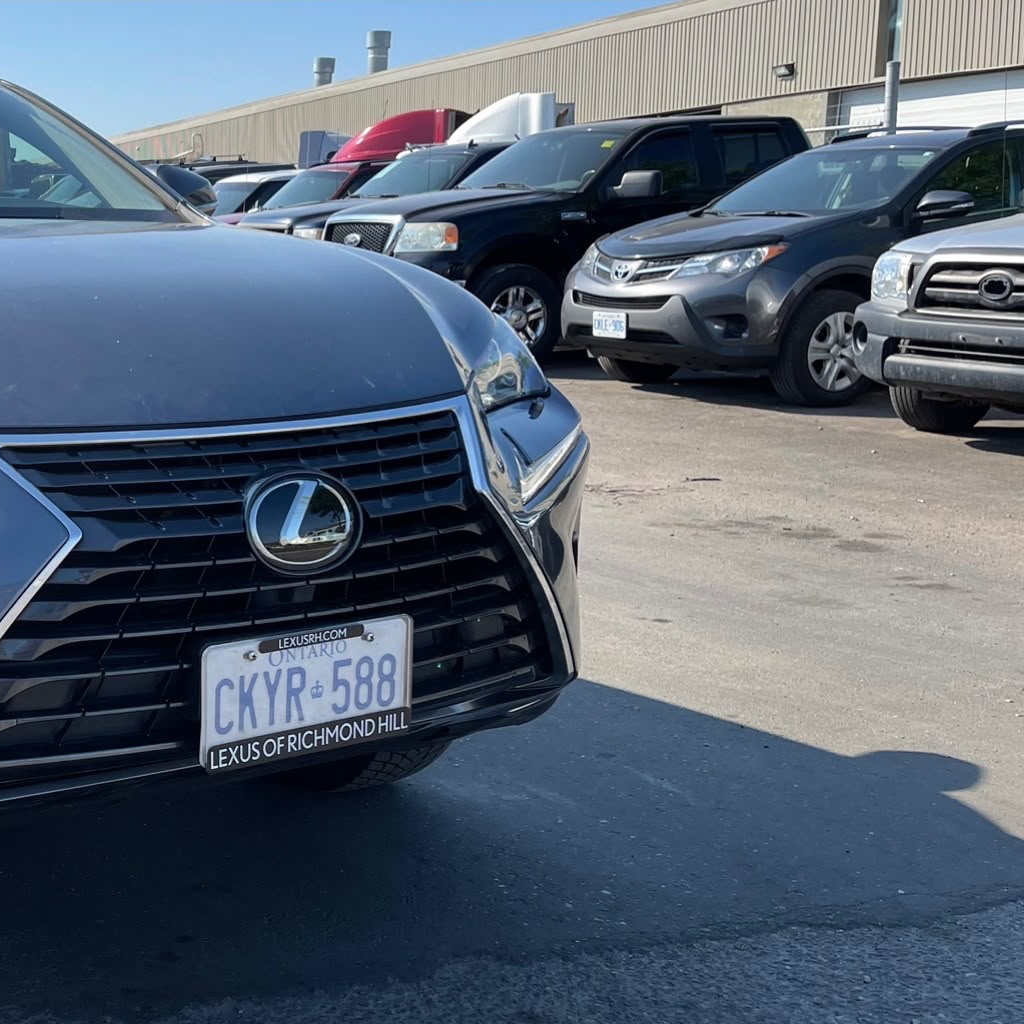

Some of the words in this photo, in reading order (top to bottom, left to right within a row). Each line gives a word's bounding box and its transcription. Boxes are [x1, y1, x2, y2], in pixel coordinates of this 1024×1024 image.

[268, 641, 347, 667] ONTARIO
[278, 627, 348, 649] LEXUSRH.COM
[214, 666, 306, 735] CKYR
[331, 653, 397, 715] 588
[210, 741, 261, 770] LEXUS
[262, 736, 286, 759] OF
[287, 718, 376, 753] RICHMOND
[377, 711, 408, 733] HILL
